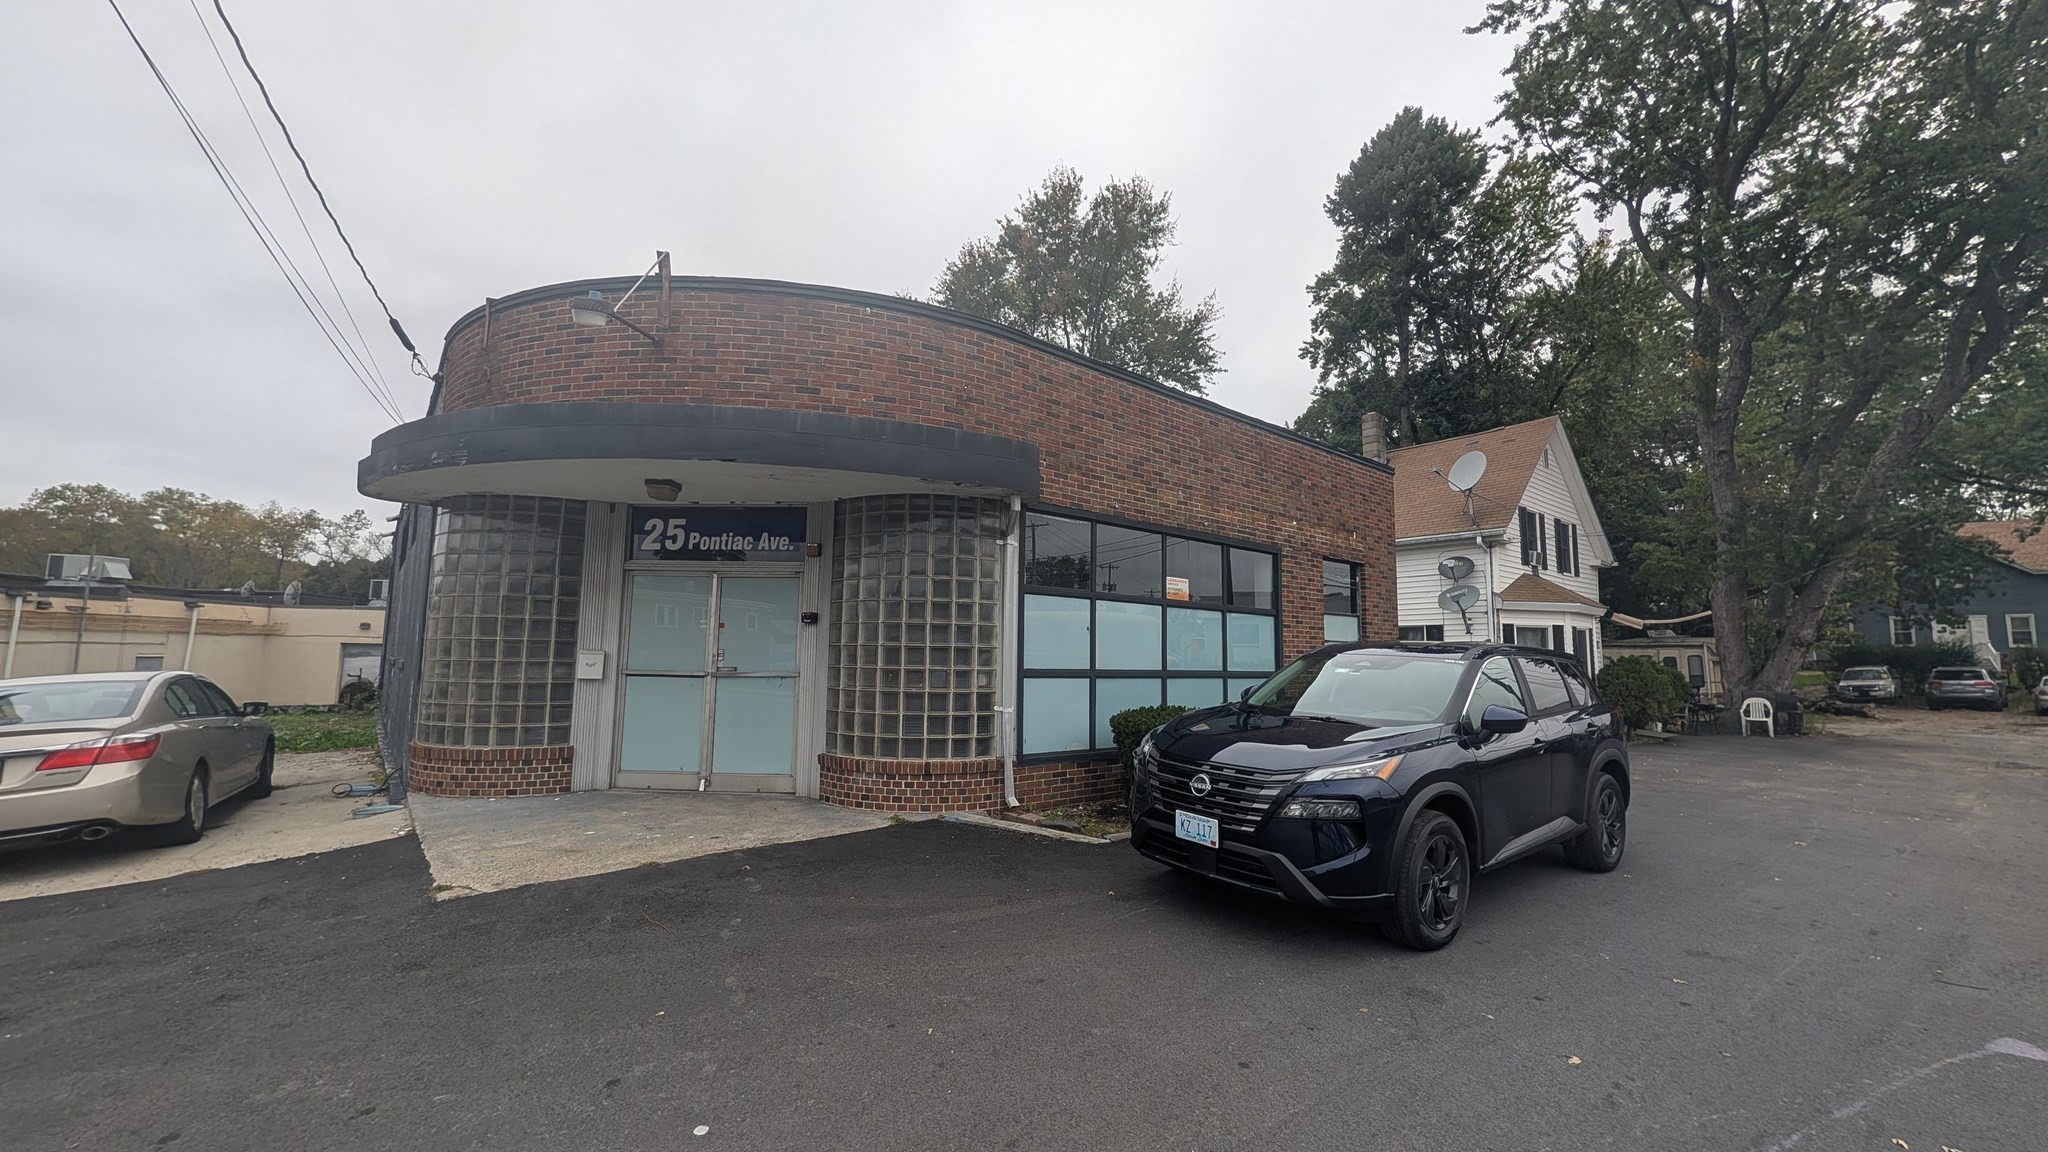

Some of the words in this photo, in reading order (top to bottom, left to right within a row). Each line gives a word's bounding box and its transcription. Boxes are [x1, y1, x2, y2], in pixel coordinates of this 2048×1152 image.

[641, 518, 687, 551] 25
[688, 532, 753, 551] Pontiac
[758, 532, 794, 550] Ave.
[1180, 818, 1191, 833] KZ
[1197, 822, 1213, 839] 117
